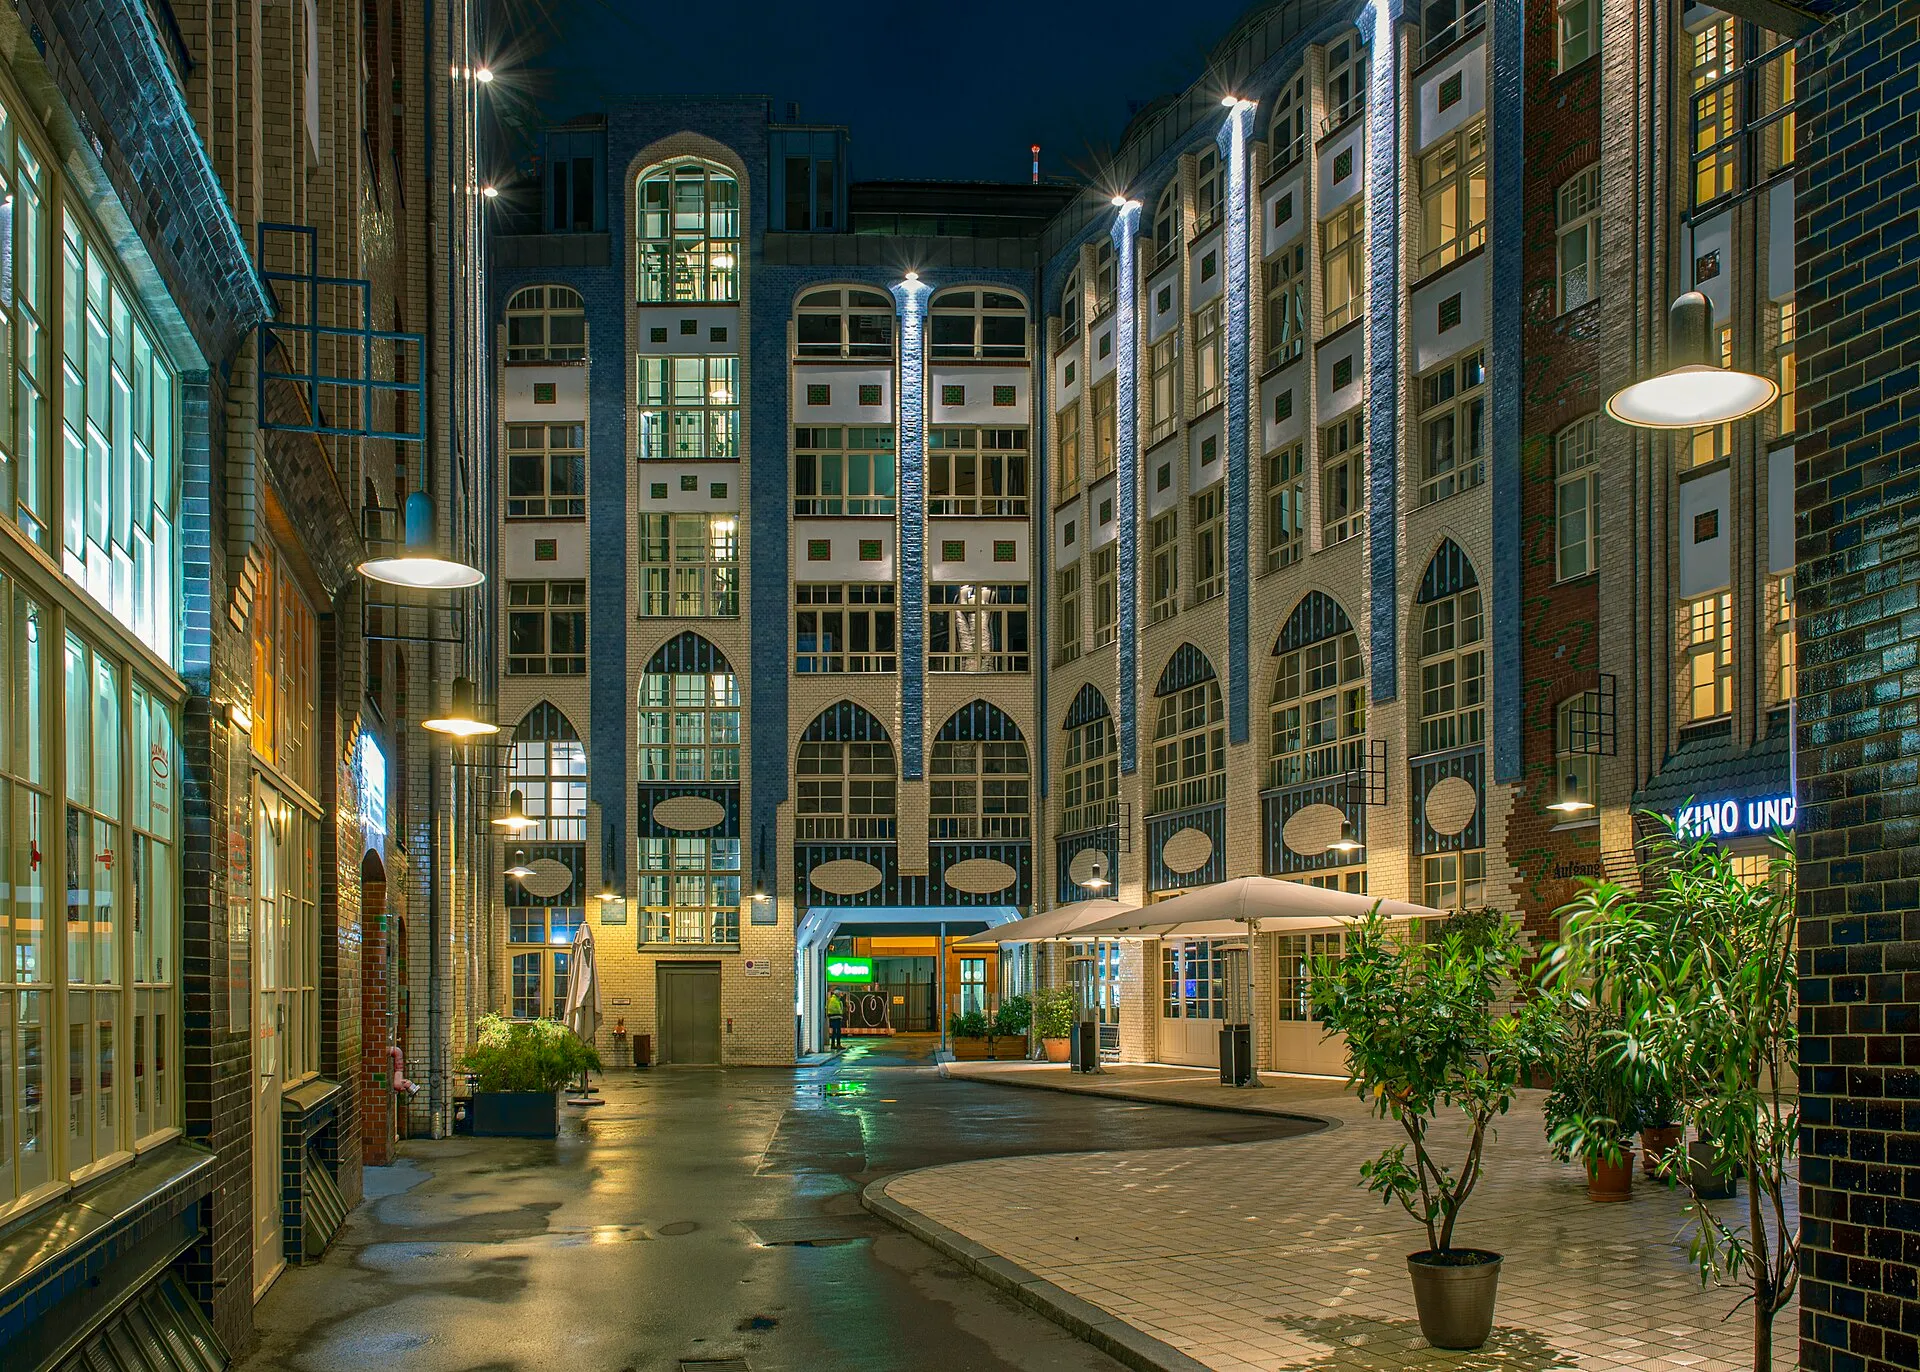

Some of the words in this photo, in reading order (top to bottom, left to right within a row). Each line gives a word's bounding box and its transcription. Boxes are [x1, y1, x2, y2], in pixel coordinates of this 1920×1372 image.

[1678, 800, 1739, 839] KINO
[1748, 797, 1797, 829] UND
[1553, 860, 1601, 879] Aufgang
